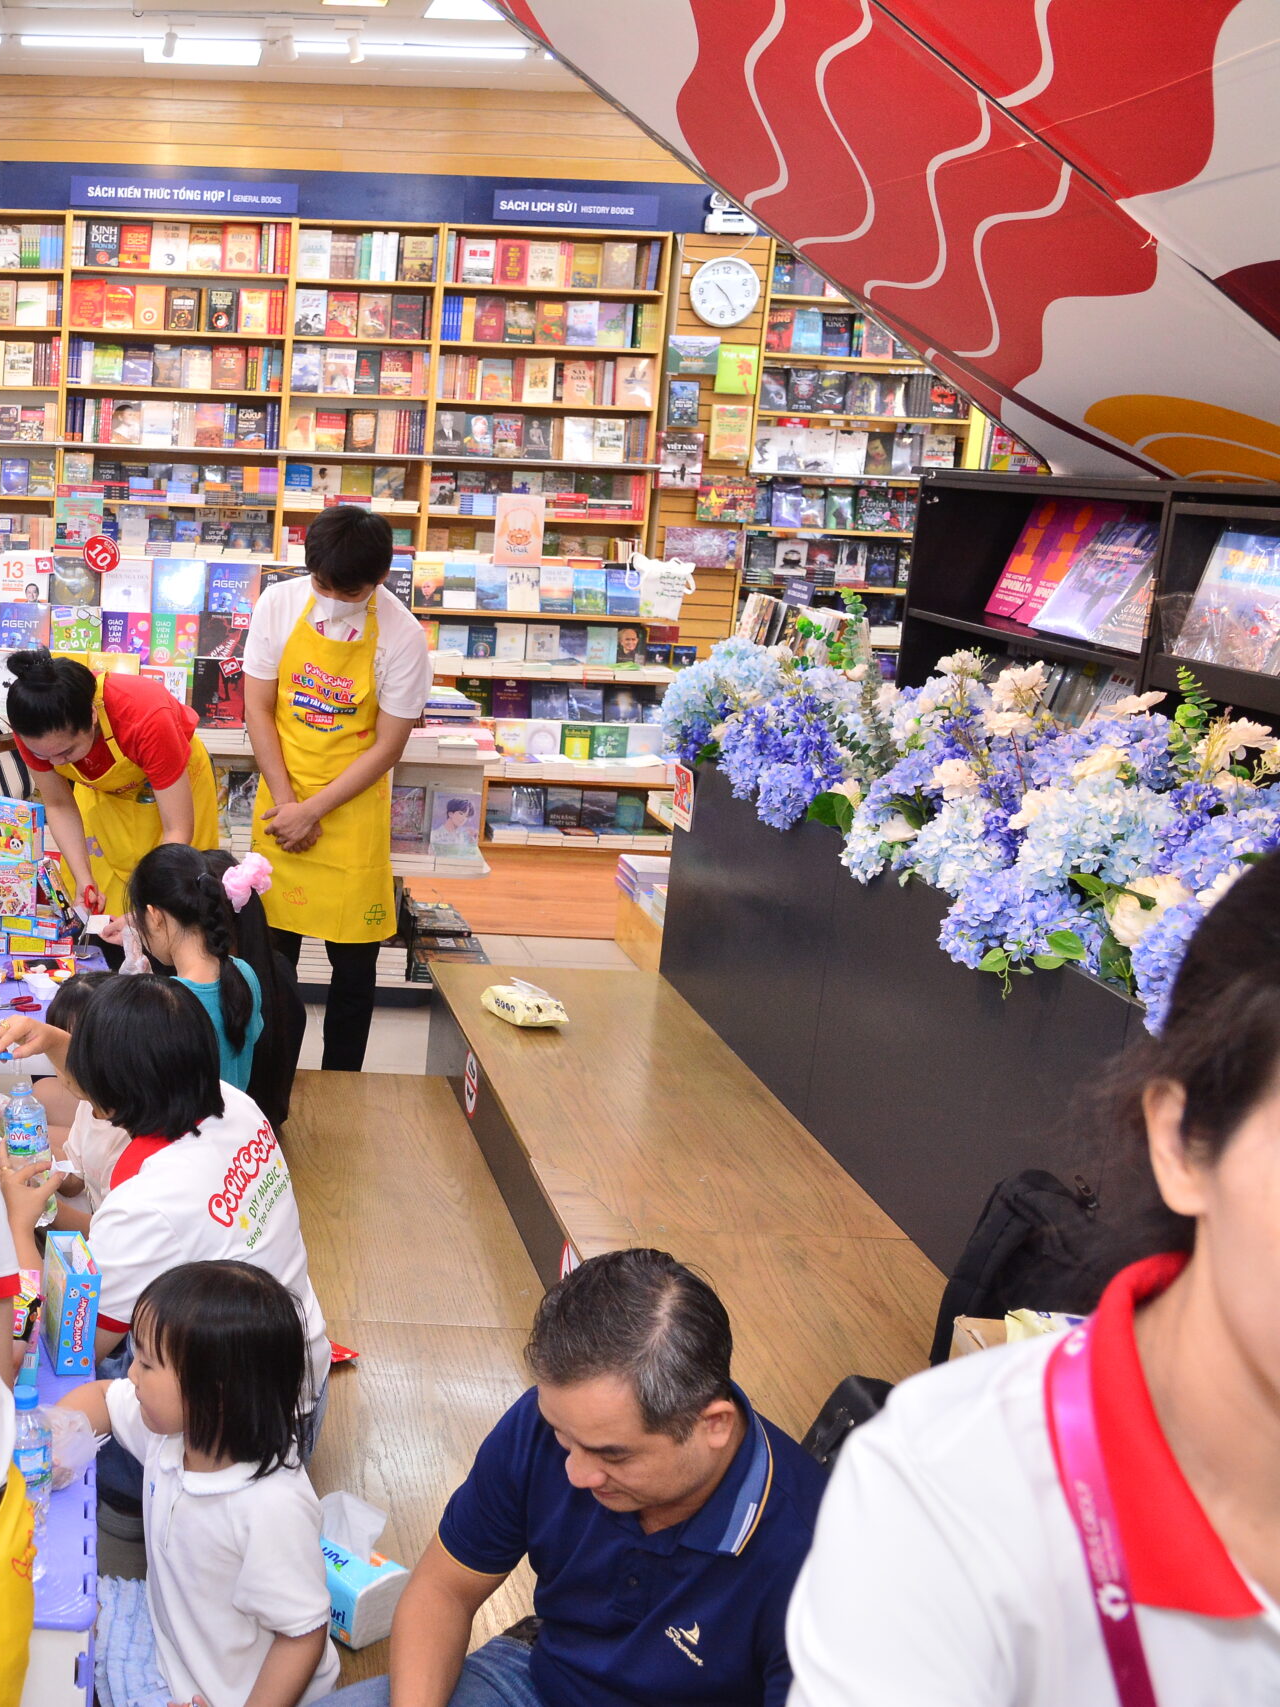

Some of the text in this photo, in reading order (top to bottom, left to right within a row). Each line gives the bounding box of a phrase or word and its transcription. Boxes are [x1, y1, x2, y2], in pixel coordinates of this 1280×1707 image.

[87, 185, 282, 204] SÁCH KIẾN THỨC TỔNG HỢP GENERAL BOOKS
[500, 200, 634, 215] SÁCH LỊCH SỬ HISTORY BOOKS
[91, 225, 117, 235] KINH
[91, 234, 117, 243] DỊCH
[723, 266, 731, 274] 12
[720, 310, 725, 318] 6
[3, 561, 24, 578] 13
[213, 579, 250, 589] AGENT
[1, 620, 39, 628] AGENT
[292, 673, 314, 688] KẸO
[248, 1166, 281, 1219] DIY MAGIC
[246, 1227, 263, 1250] Sáng
[258, 1212, 268, 1226] Tạo
[273, 1179, 288, 1200] Riêng
[330, 1606, 346, 1625] uri
